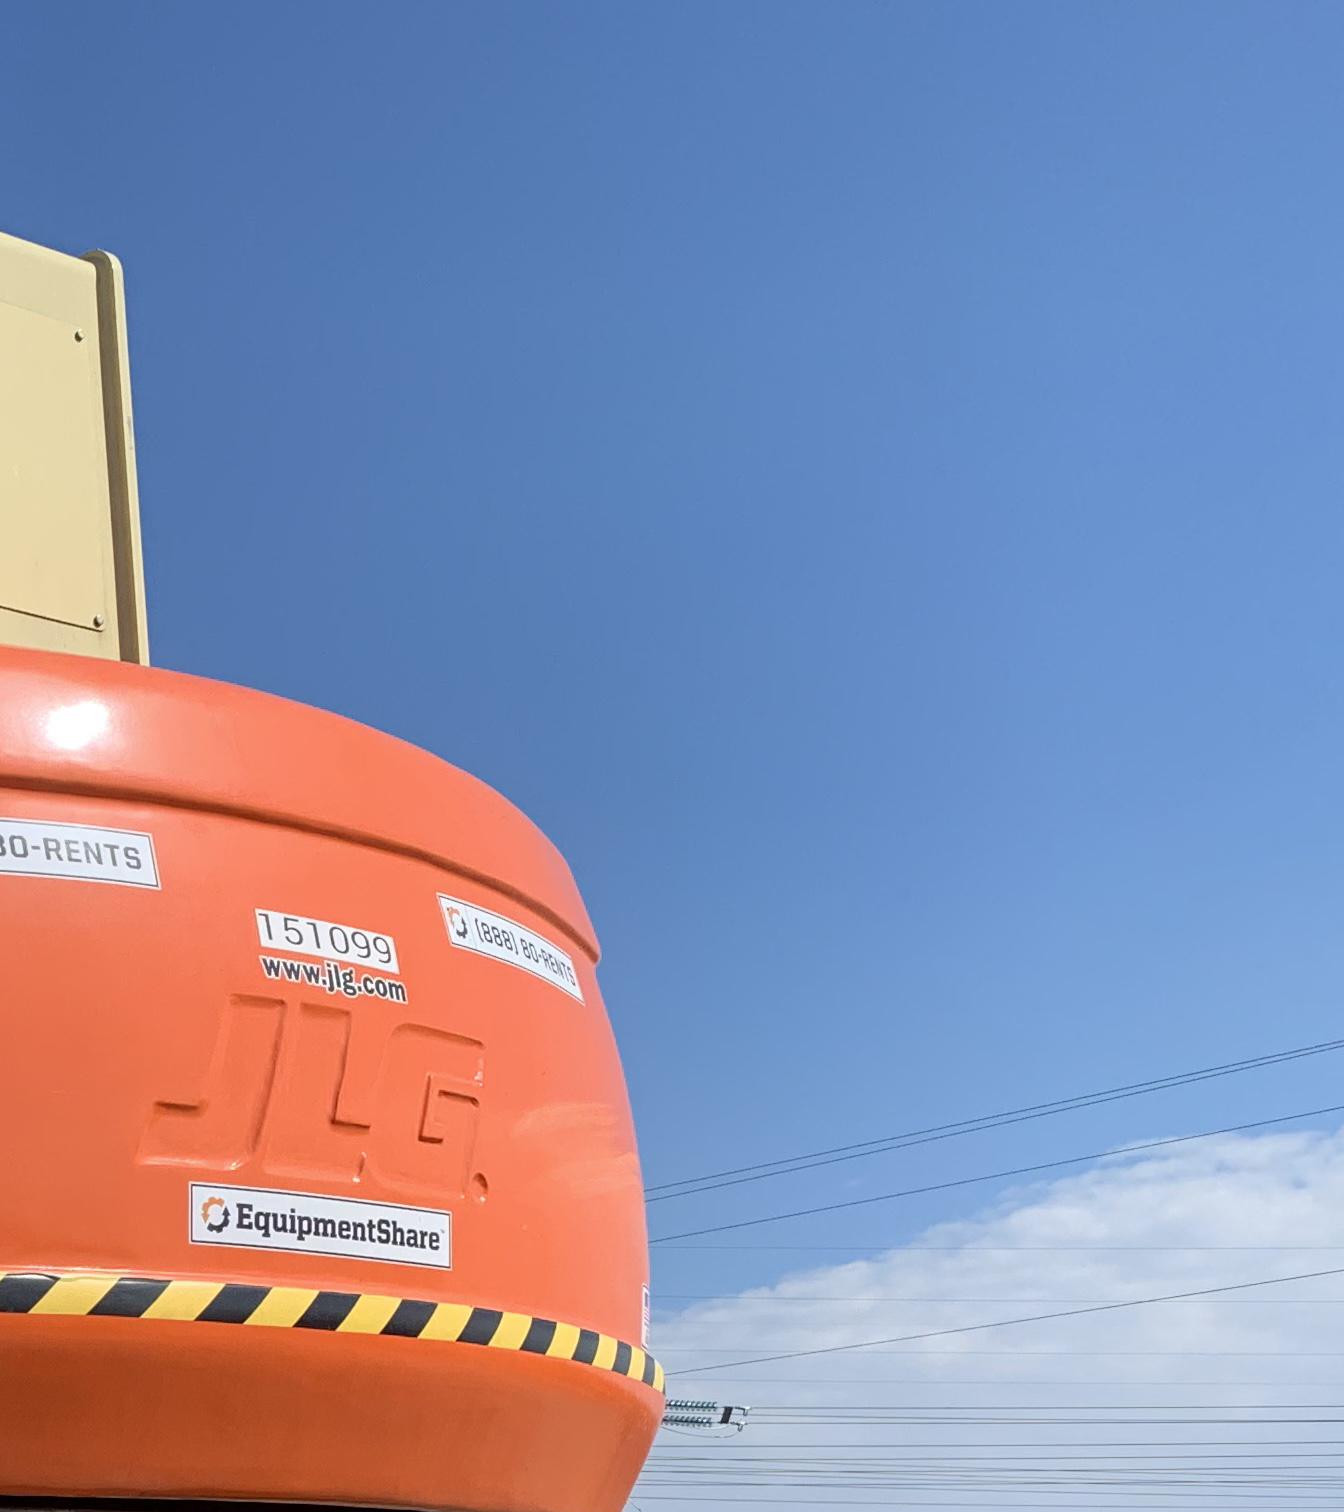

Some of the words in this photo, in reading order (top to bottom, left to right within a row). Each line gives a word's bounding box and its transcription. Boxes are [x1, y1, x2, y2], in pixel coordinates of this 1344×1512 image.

[258, 912, 392, 964] 151099
[475, 917, 517, 956] (888)
[522, 938, 577, 986] 80-RENTS
[262, 957, 406, 1002] www.jlg.com
[136, 993, 485, 1200] JLG
[236, 1203, 441, 1251] EquipmentShare
